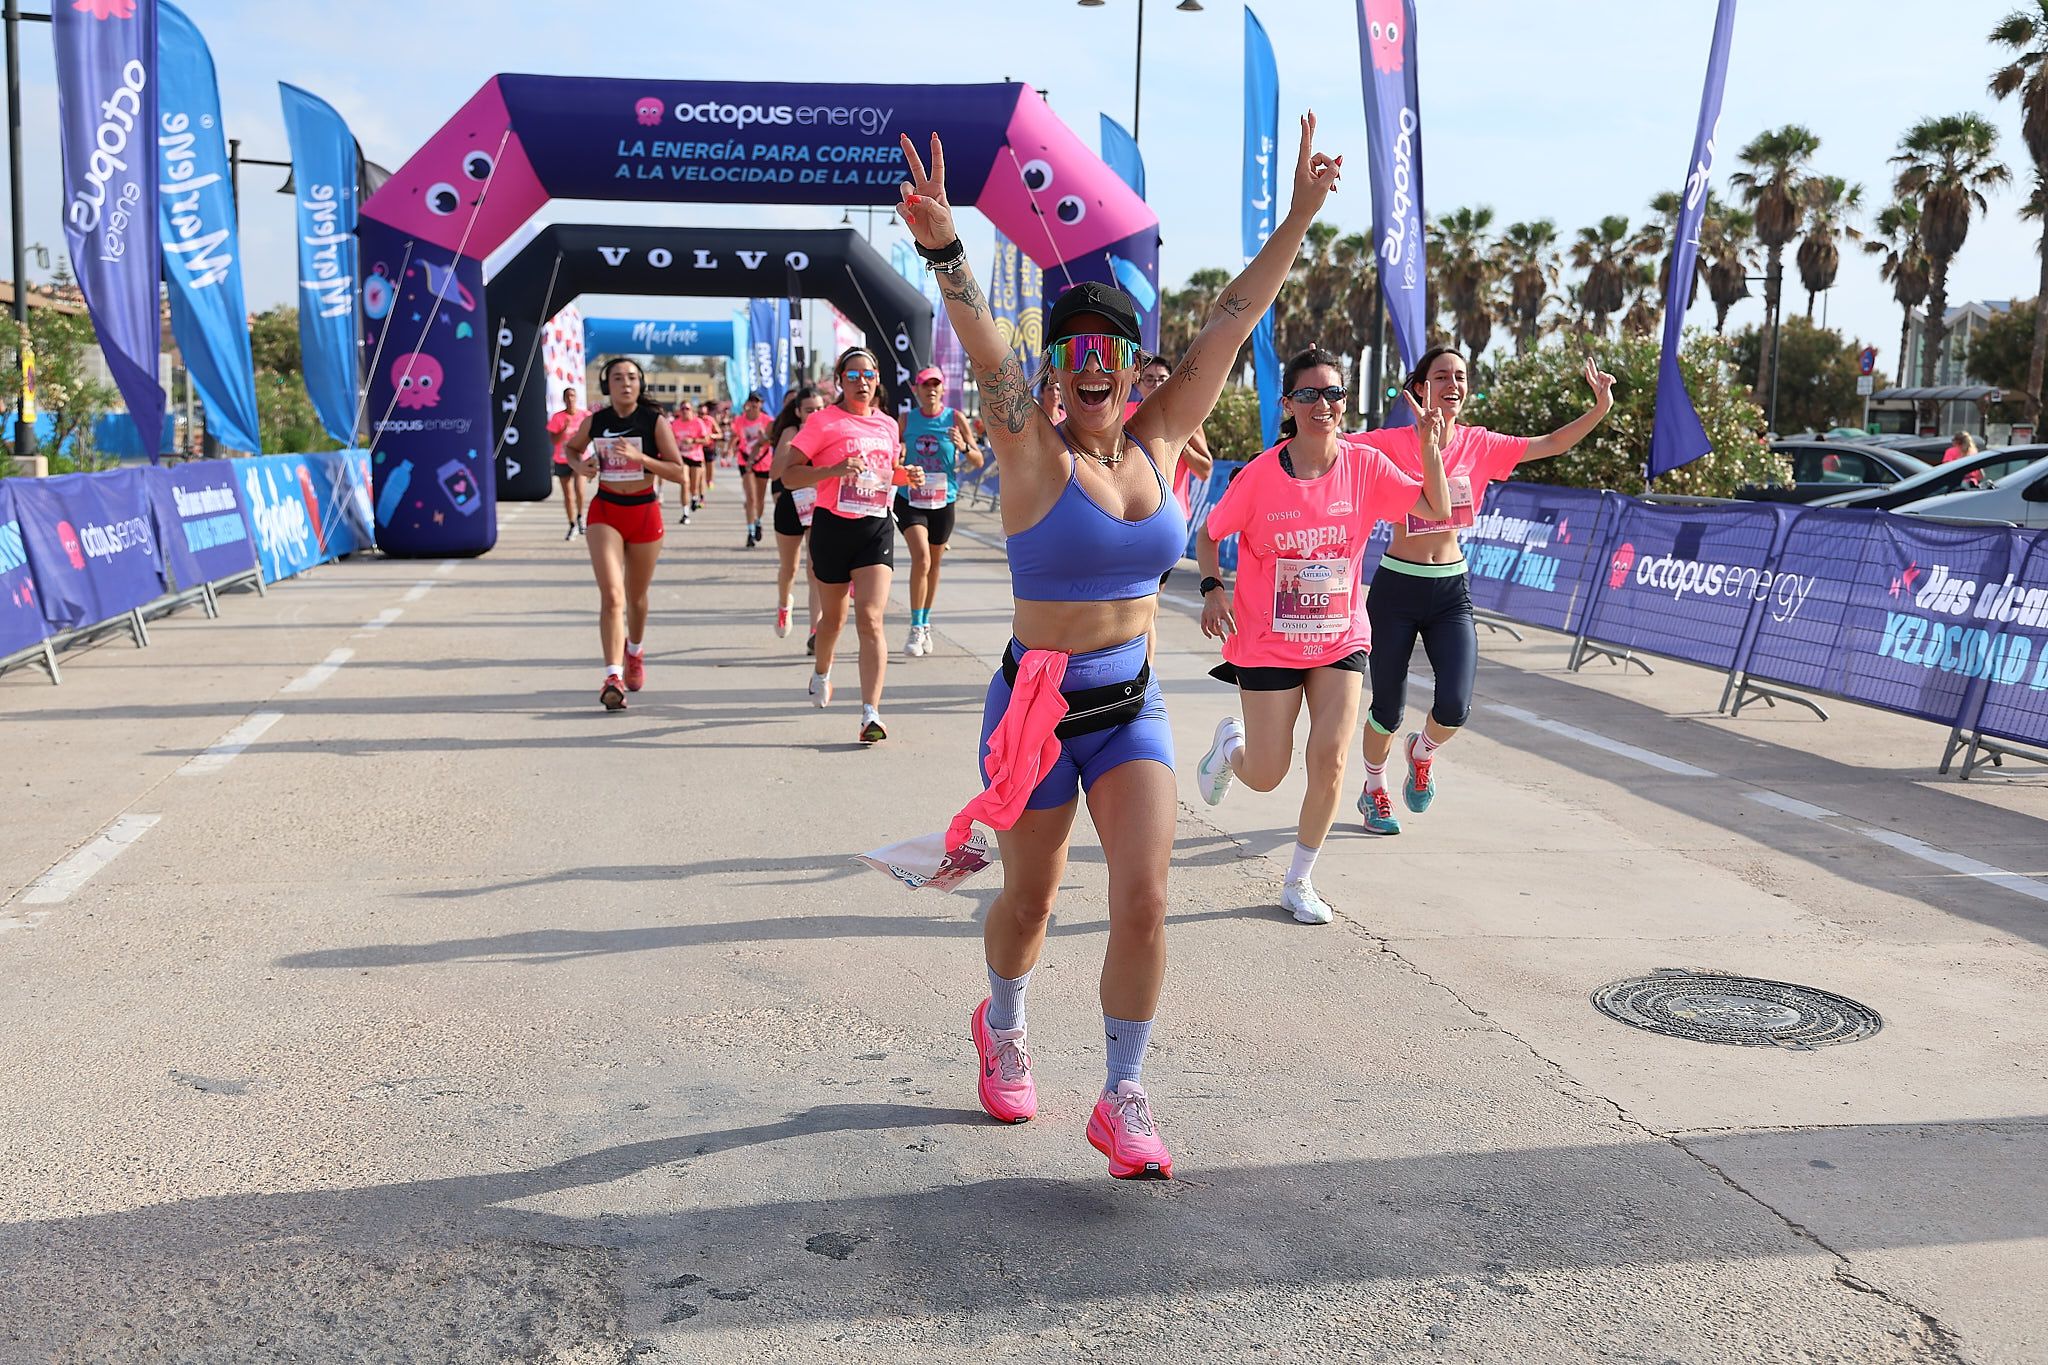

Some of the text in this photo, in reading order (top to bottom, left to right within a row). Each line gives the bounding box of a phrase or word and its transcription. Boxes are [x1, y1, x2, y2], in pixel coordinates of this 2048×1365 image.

[674, 101, 894, 136] octopus energy
[617, 138, 903, 163] LA ENERGÍA PARA CORRER
[614, 163, 908, 186] A LA VELOCIDAD DE LA LUZ
[597, 246, 810, 271] VOLVO
[497, 327, 522, 481] VOLVO
[1266, 510, 1301, 521] OYSHO
[1274, 524, 1347, 551] CARRERA
[1511, 552, 1561, 592] FINAL
[1300, 593, 1330, 606] 016
[1635, 553, 1815, 623] octopus energy
[1916, 564, 1977, 616] Has
[1302, 644, 1324, 656] 2026
[1877, 611, 2032, 686] VELOCIDAD
